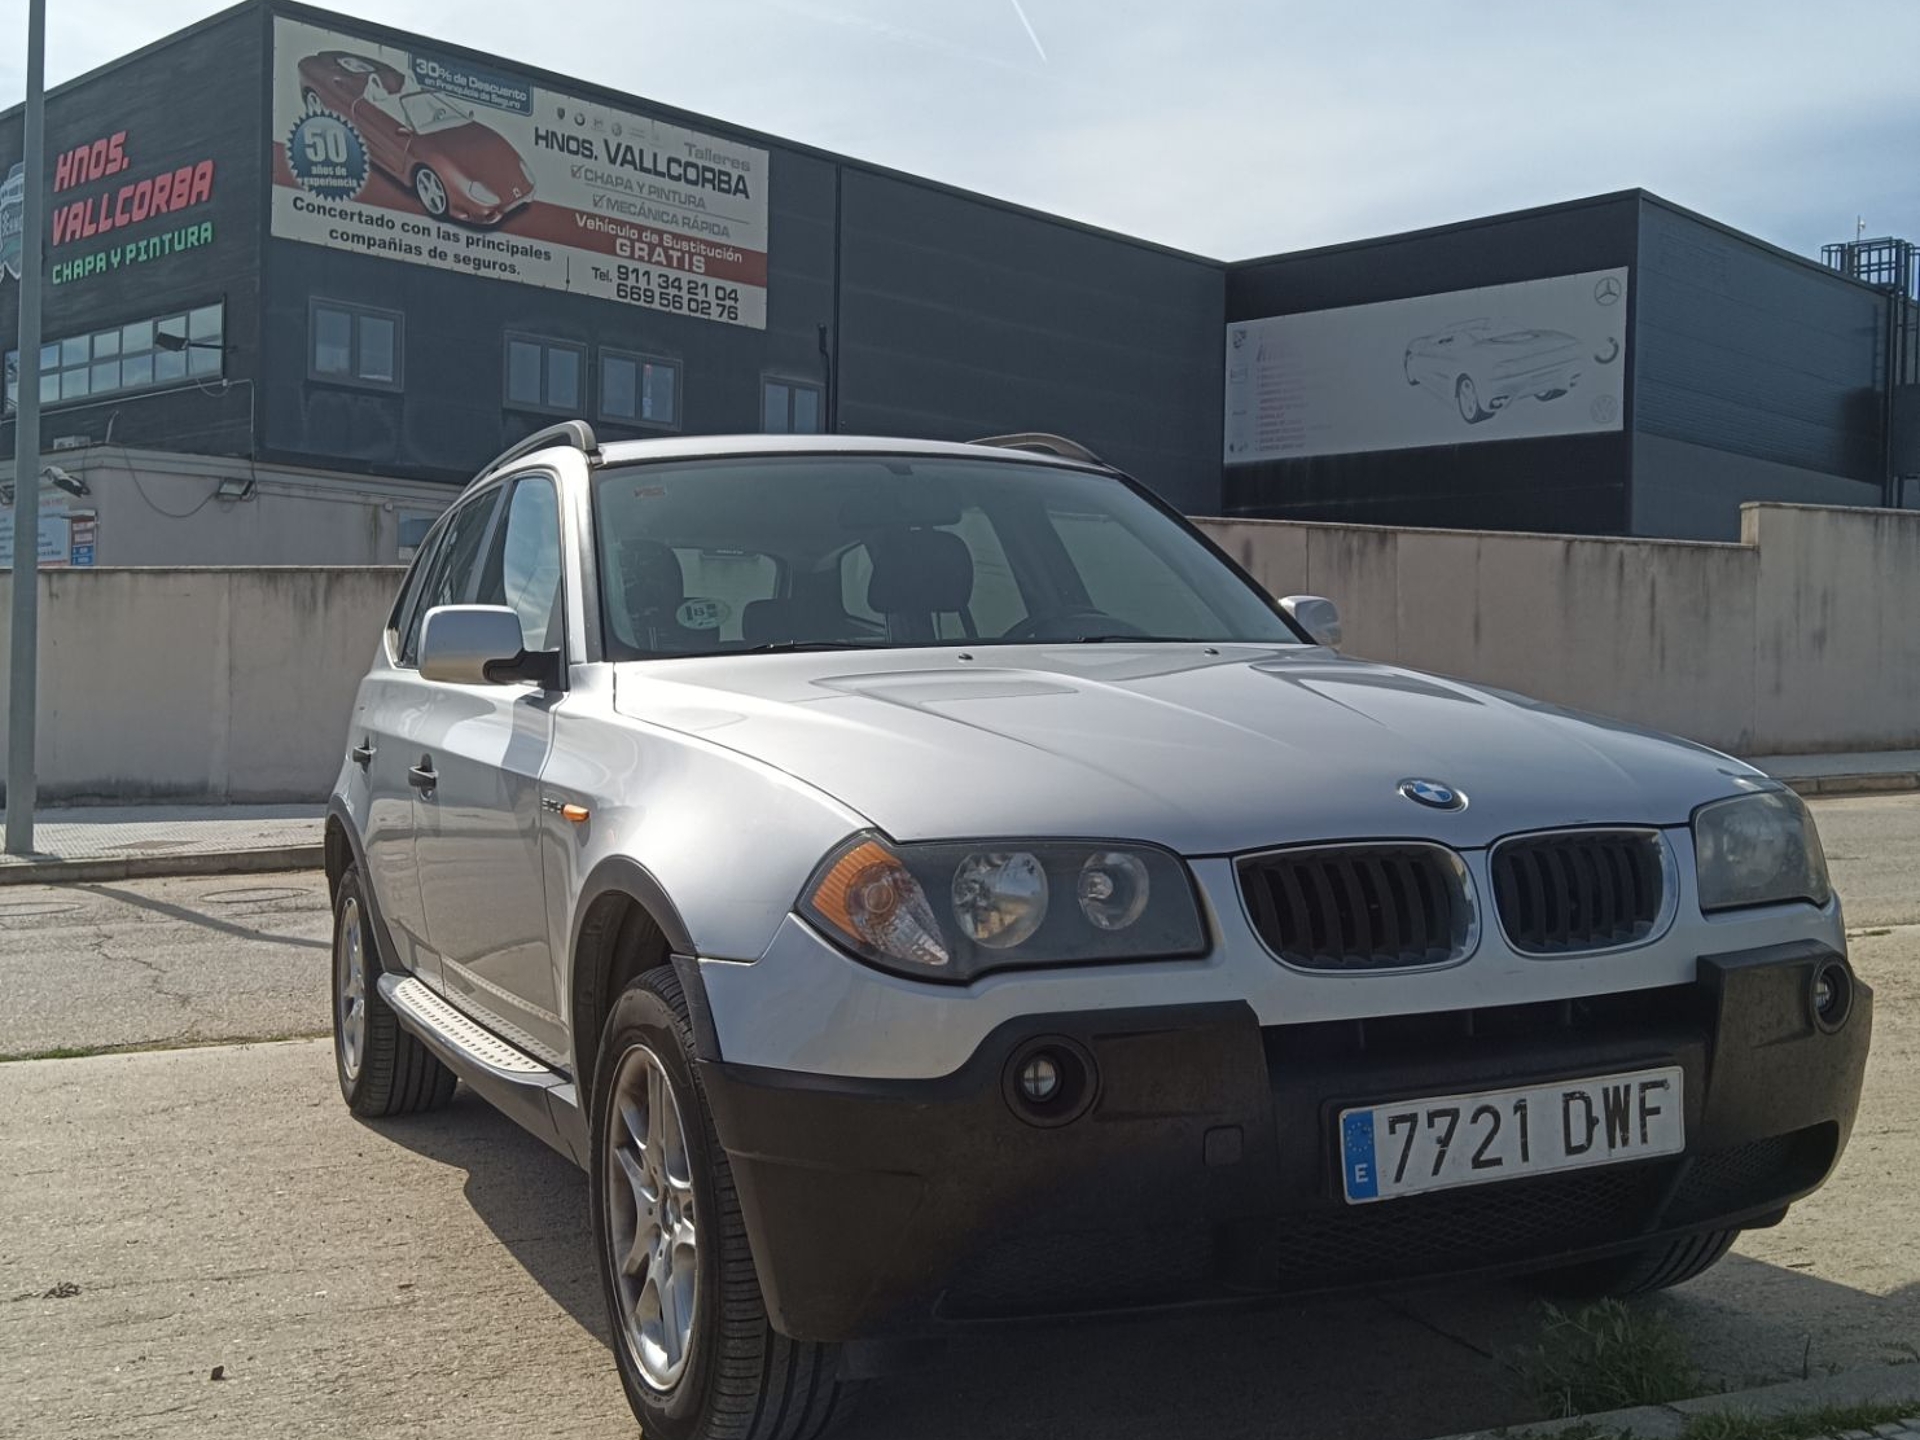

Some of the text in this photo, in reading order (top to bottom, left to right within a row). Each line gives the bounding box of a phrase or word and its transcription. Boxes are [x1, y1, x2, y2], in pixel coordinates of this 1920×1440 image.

[416, 58, 452, 81] 30%
[469, 76, 527, 101] Descuento
[54, 130, 130, 193] HNOS.
[303, 127, 347, 162] 50
[535, 127, 750, 199] HNOS. VALLCORBA
[684, 142, 750, 172] Talleres
[335, 165, 347, 176] de
[584, 168, 706, 210] CHAPA Y PINTURA
[52, 159, 214, 246] VALLCORBA
[606, 197, 730, 238] MECÁNICA RÁPIDA
[292, 196, 552, 262] Concertado con las principales
[575, 213, 742, 263] Vehículo de Sustitución
[52, 221, 212, 285] CHAPA Y PINTURA
[428, 246, 448, 262] de
[453, 254, 521, 275] seguros.
[616, 238, 706, 273] GRATIS
[591, 265, 739, 304] Tel. 911 34 21 04
[616, 283, 738, 321] 669 56 02 76
[1388, 1079, 1669, 1184] 7721 DWF
[1355, 1164, 1368, 1183] E
